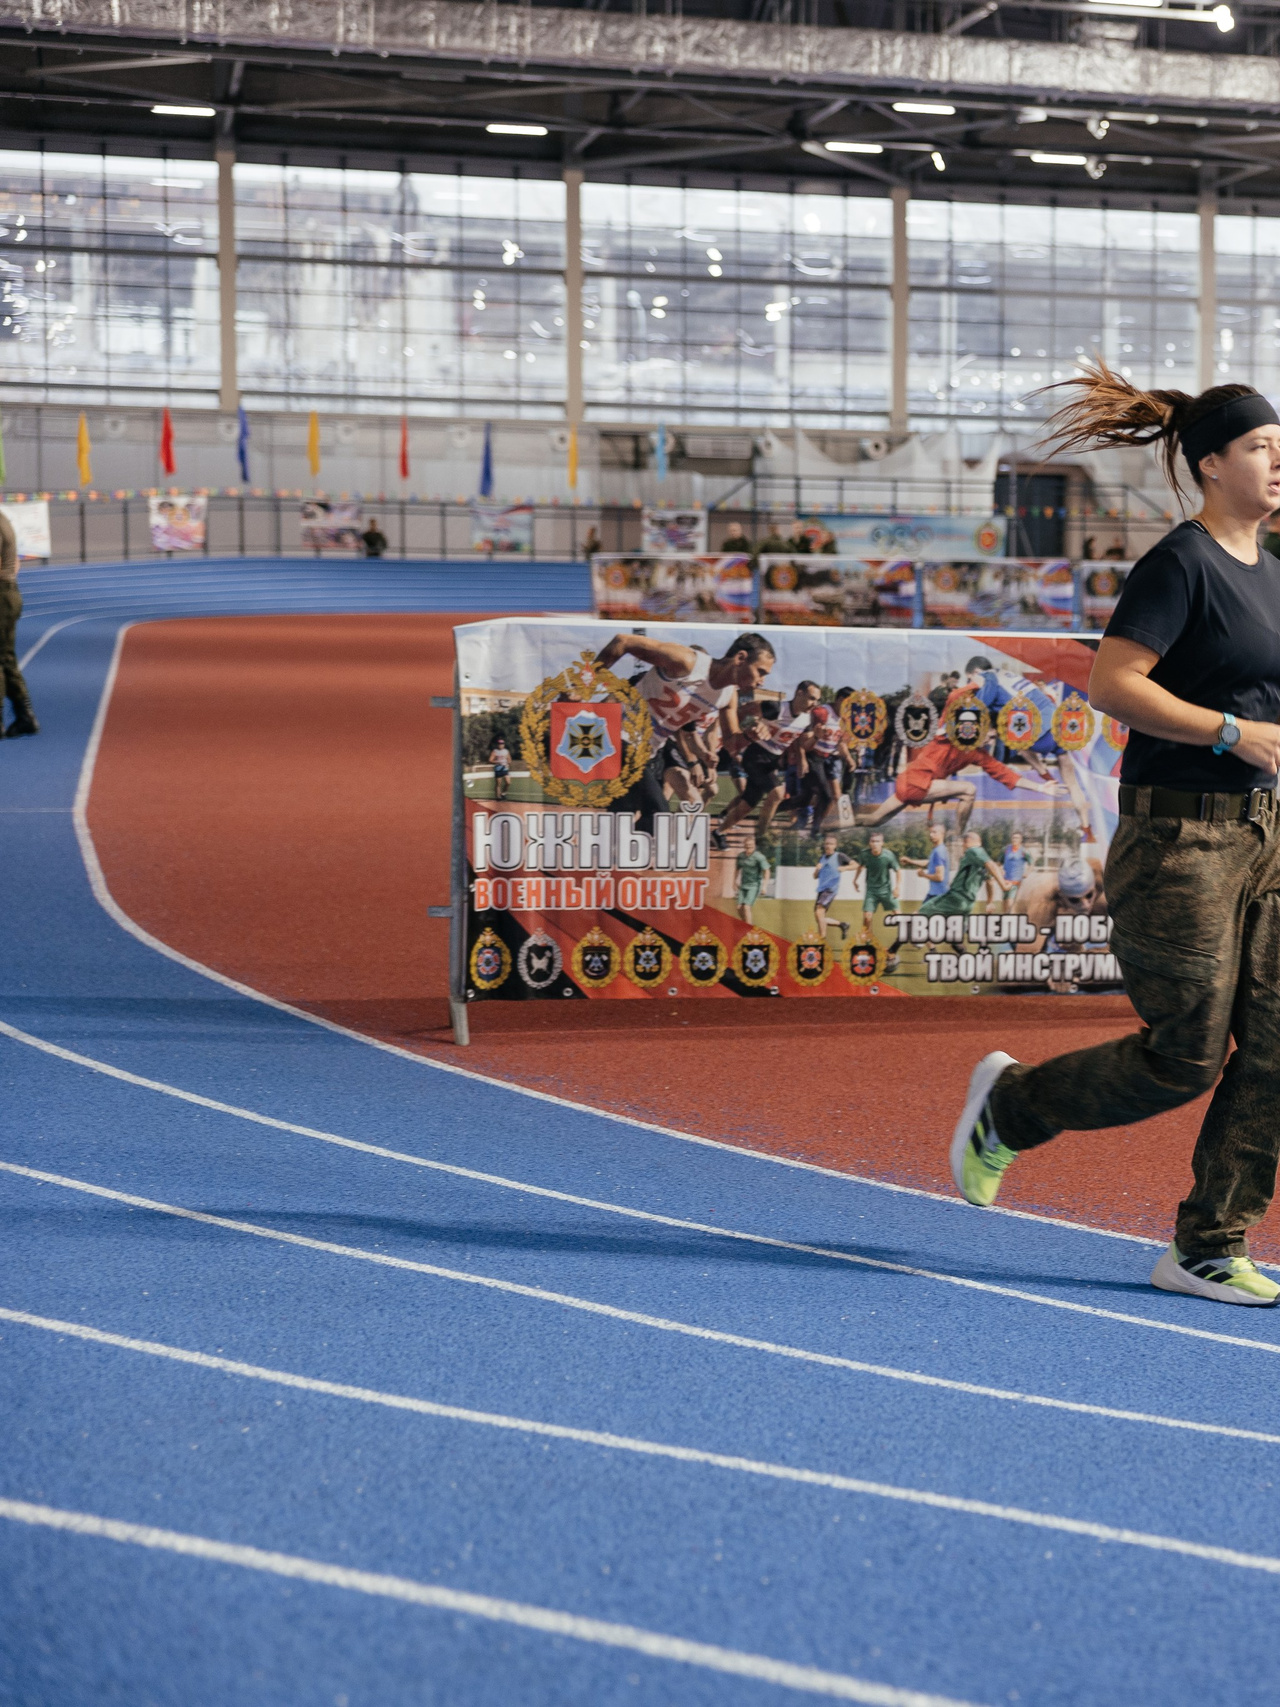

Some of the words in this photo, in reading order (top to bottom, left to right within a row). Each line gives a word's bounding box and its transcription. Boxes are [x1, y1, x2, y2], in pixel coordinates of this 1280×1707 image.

[473, 801, 711, 872] ЮЖНЫЙ
[474, 872, 615, 911] ВОЕННЫЙ
[619, 876, 710, 911] ОКРУГ
[968, 914, 1037, 946] ЦЕЛЬ
[925, 946, 994, 982] ТВОЙ
